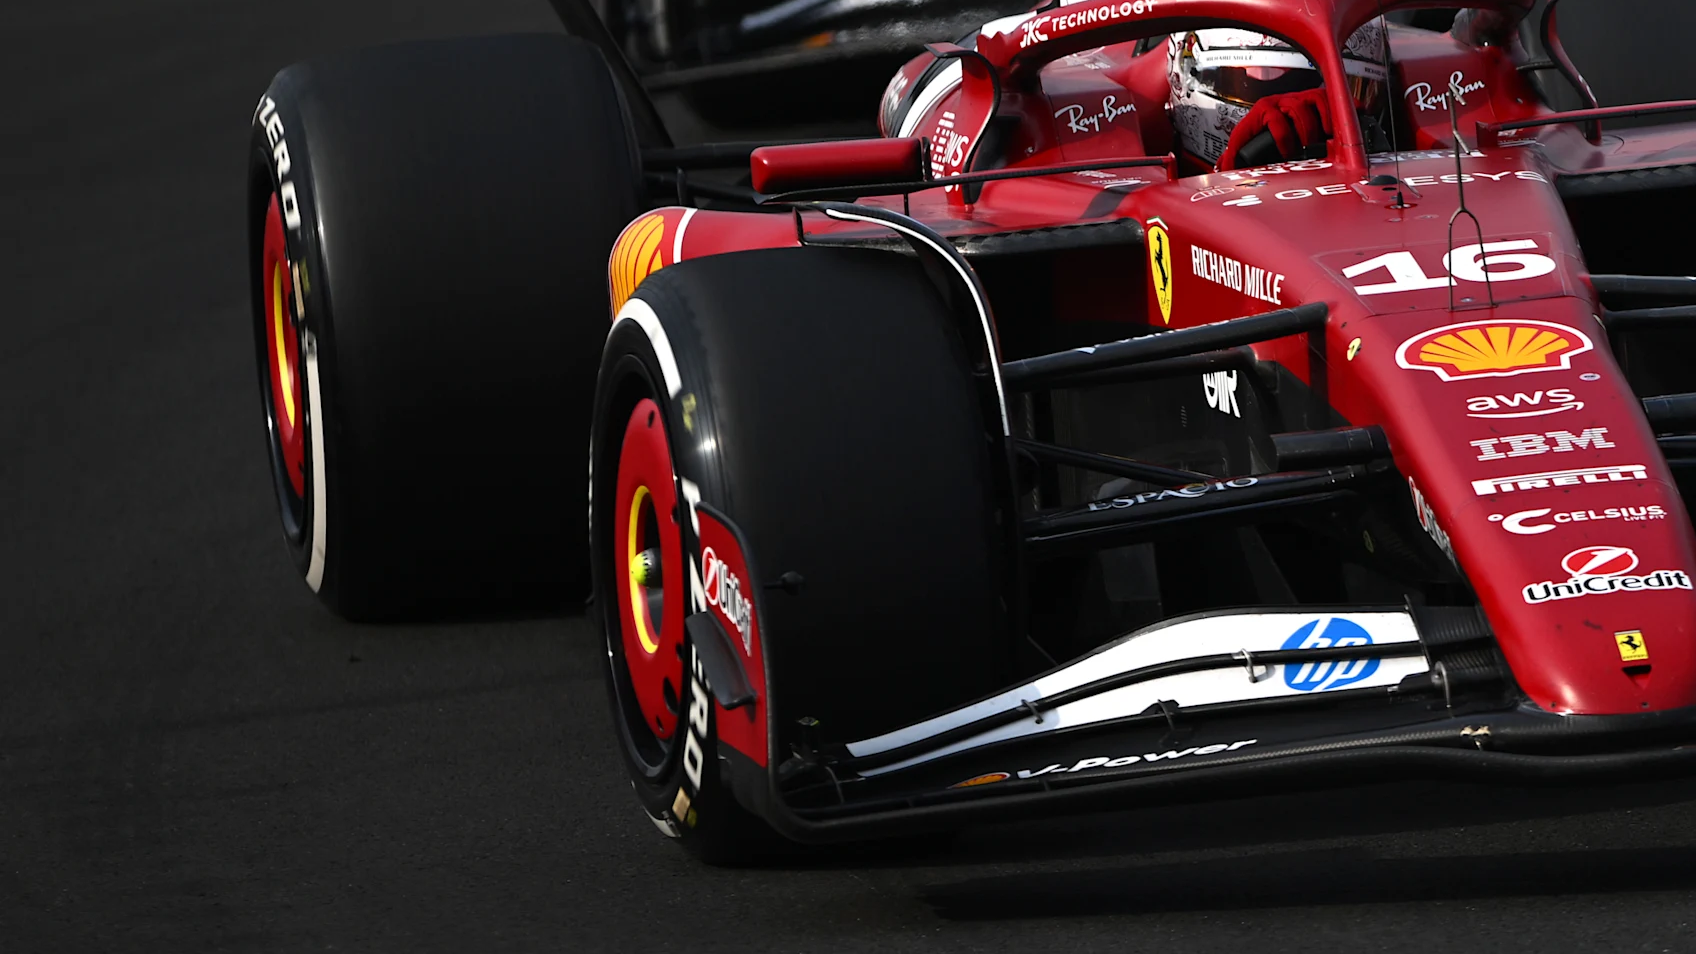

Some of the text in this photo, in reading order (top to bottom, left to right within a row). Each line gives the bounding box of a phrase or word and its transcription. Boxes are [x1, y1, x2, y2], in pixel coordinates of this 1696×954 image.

[1404, 71, 1485, 111] Ray-Ban
[1054, 95, 1137, 134] Ray-Ban
[258, 96, 301, 229] ZERO
[1273, 169, 1549, 204] GEESYS
[1191, 244, 1286, 306] RICHARD MILLE
[1342, 238, 1557, 296] 16
[1466, 388, 1576, 412] aws
[1469, 427, 1617, 461] IBM
[1471, 464, 1648, 496] PIRELLI
[1554, 505, 1666, 524] CELSIUS
[1525, 570, 1690, 602] UniCredit
[1291, 615, 1368, 692] hp
[1017, 739, 1258, 780] V-Power
